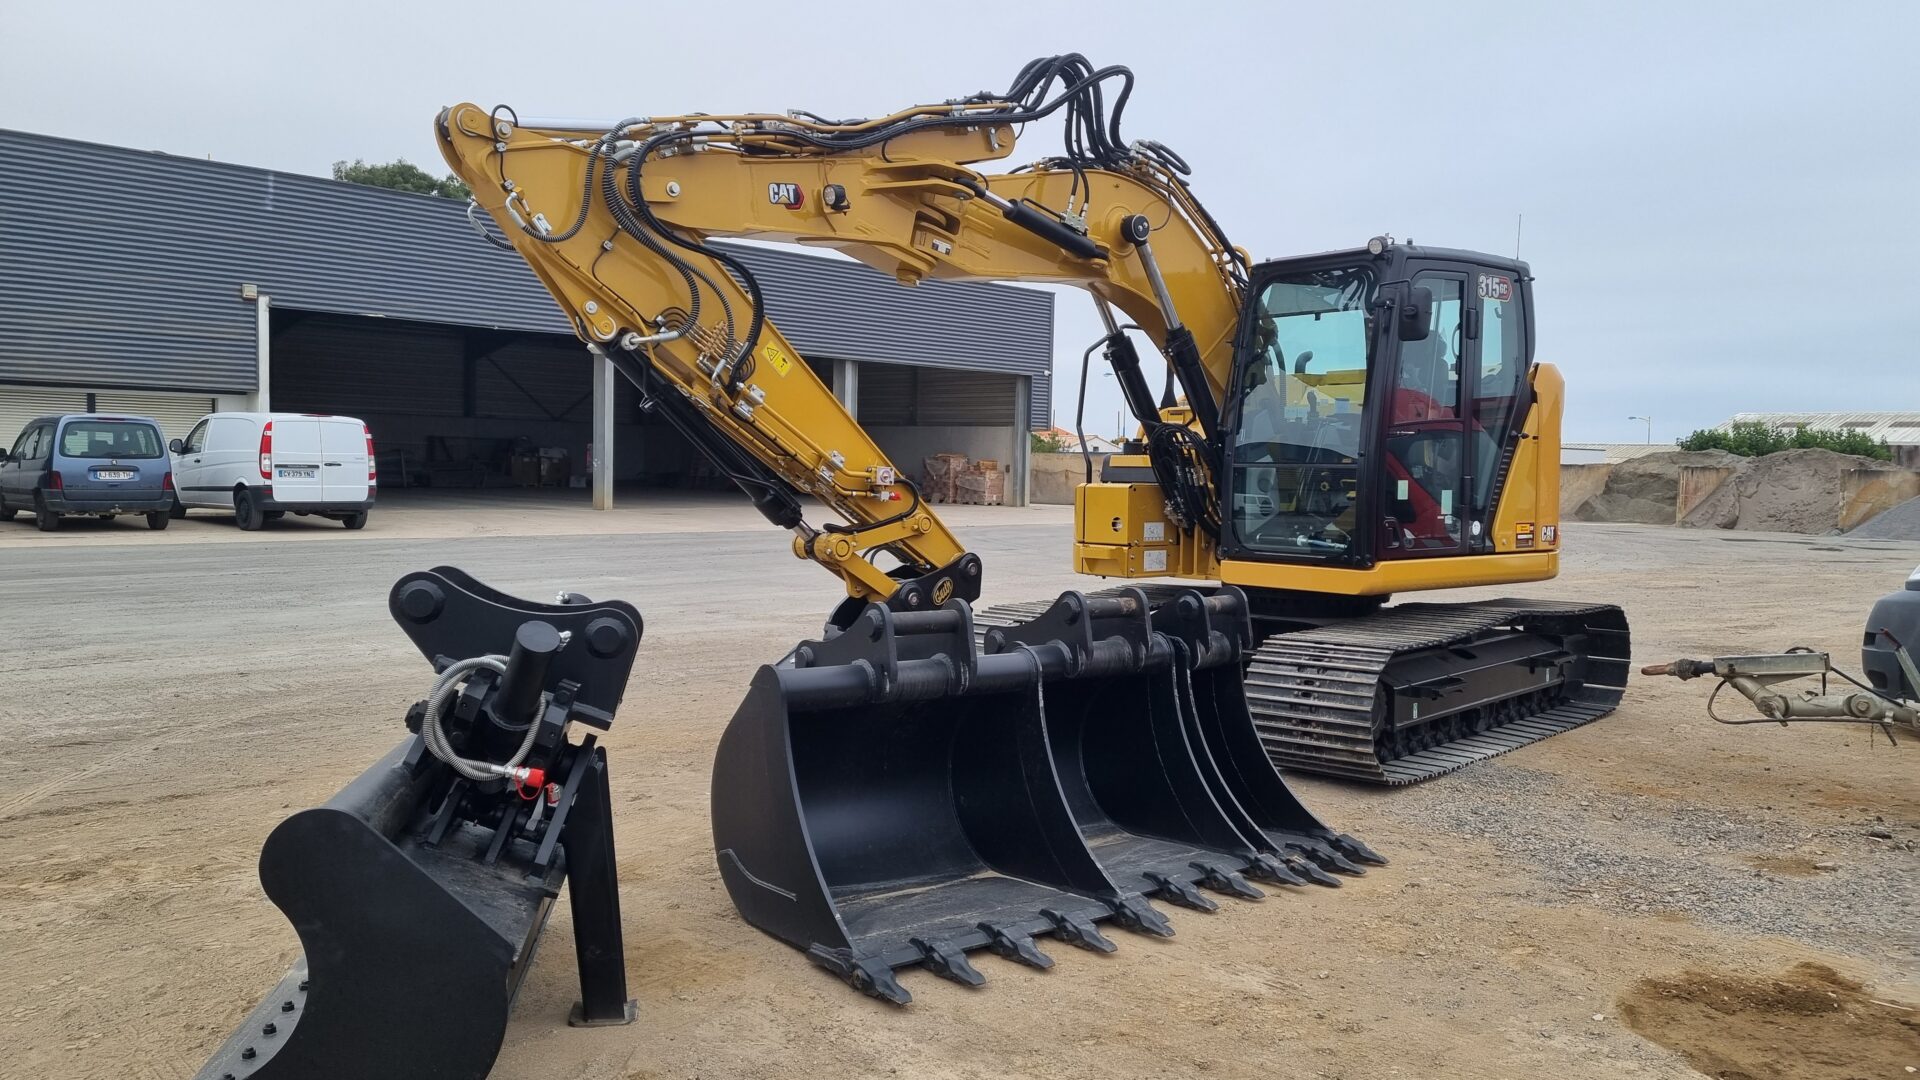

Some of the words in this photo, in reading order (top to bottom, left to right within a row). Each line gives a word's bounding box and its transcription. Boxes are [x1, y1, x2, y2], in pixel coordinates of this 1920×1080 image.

[768, 183, 796, 204] CAT
[1479, 275, 1500, 298] 315
[1541, 526, 1555, 542] CAT
